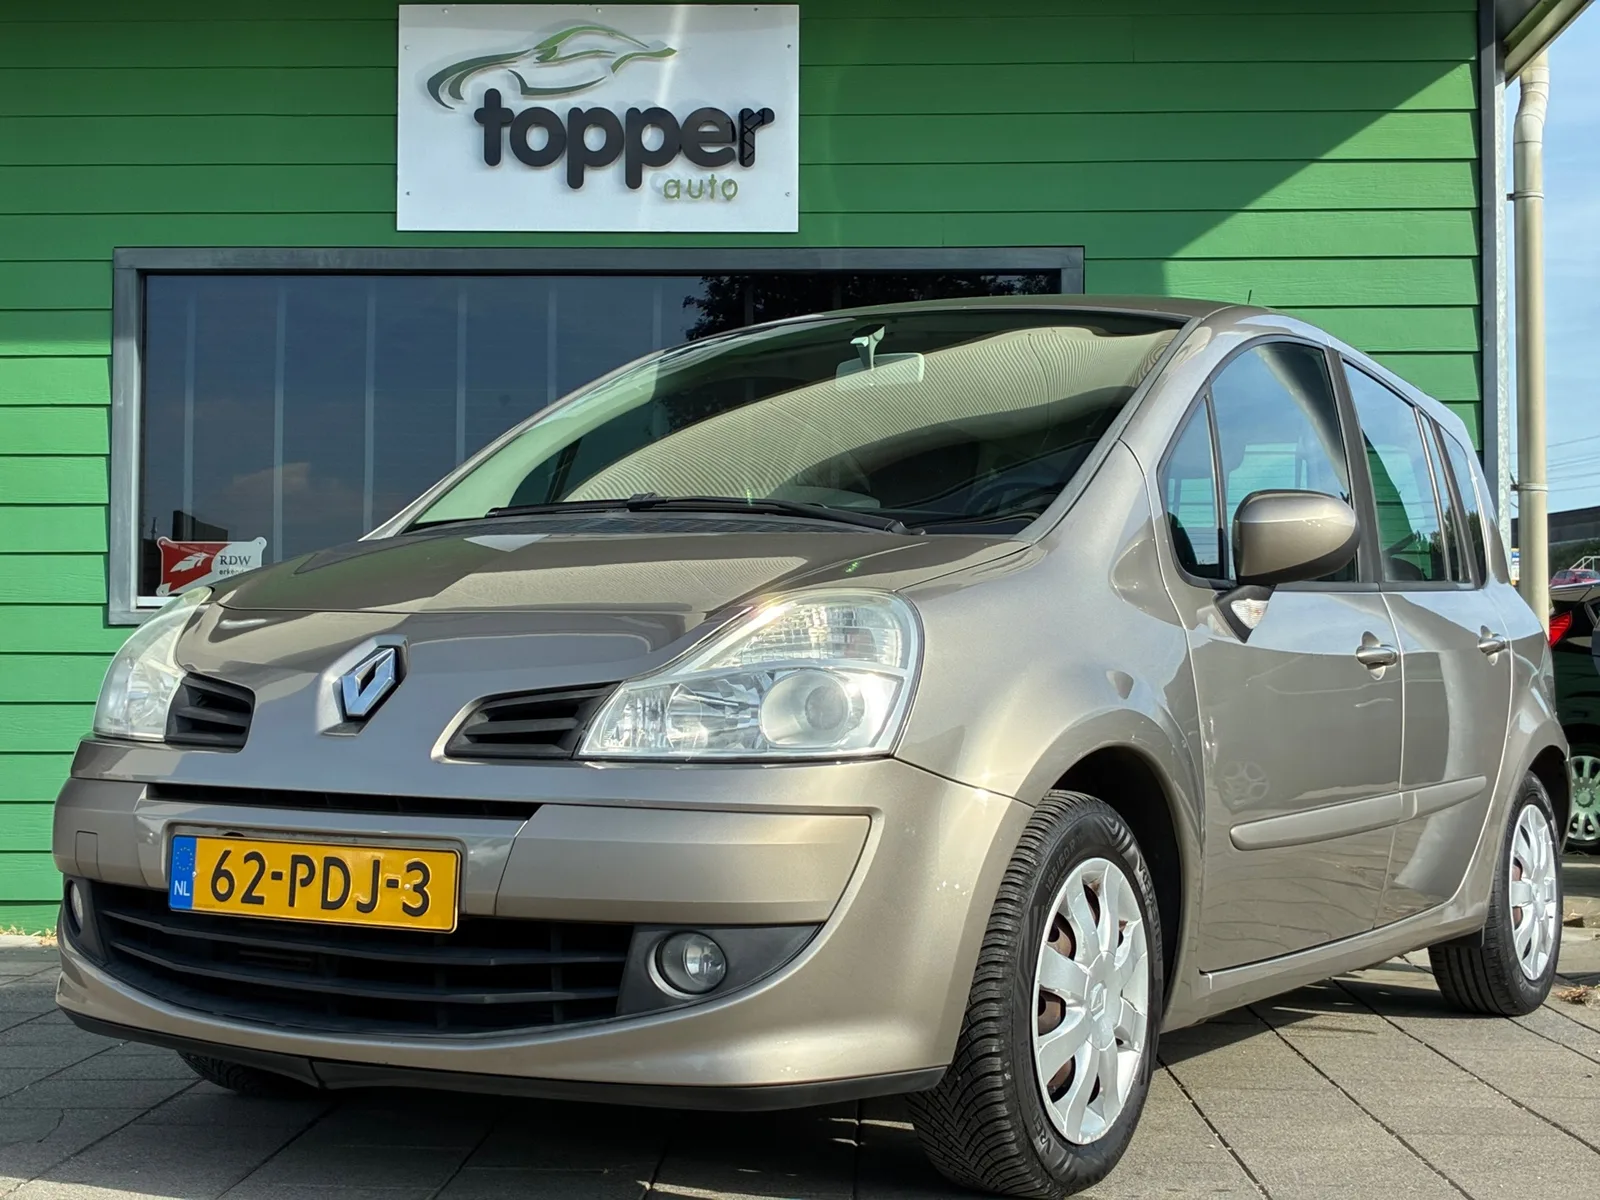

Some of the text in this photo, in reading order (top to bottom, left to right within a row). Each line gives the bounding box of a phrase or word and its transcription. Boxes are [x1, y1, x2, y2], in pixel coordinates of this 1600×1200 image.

[474, 88, 775, 190] topper
[663, 174, 739, 200] auto
[219, 555, 251, 566] RDW
[173, 879, 190, 896] NL
[210, 849, 432, 917] 62-PDJ-3
